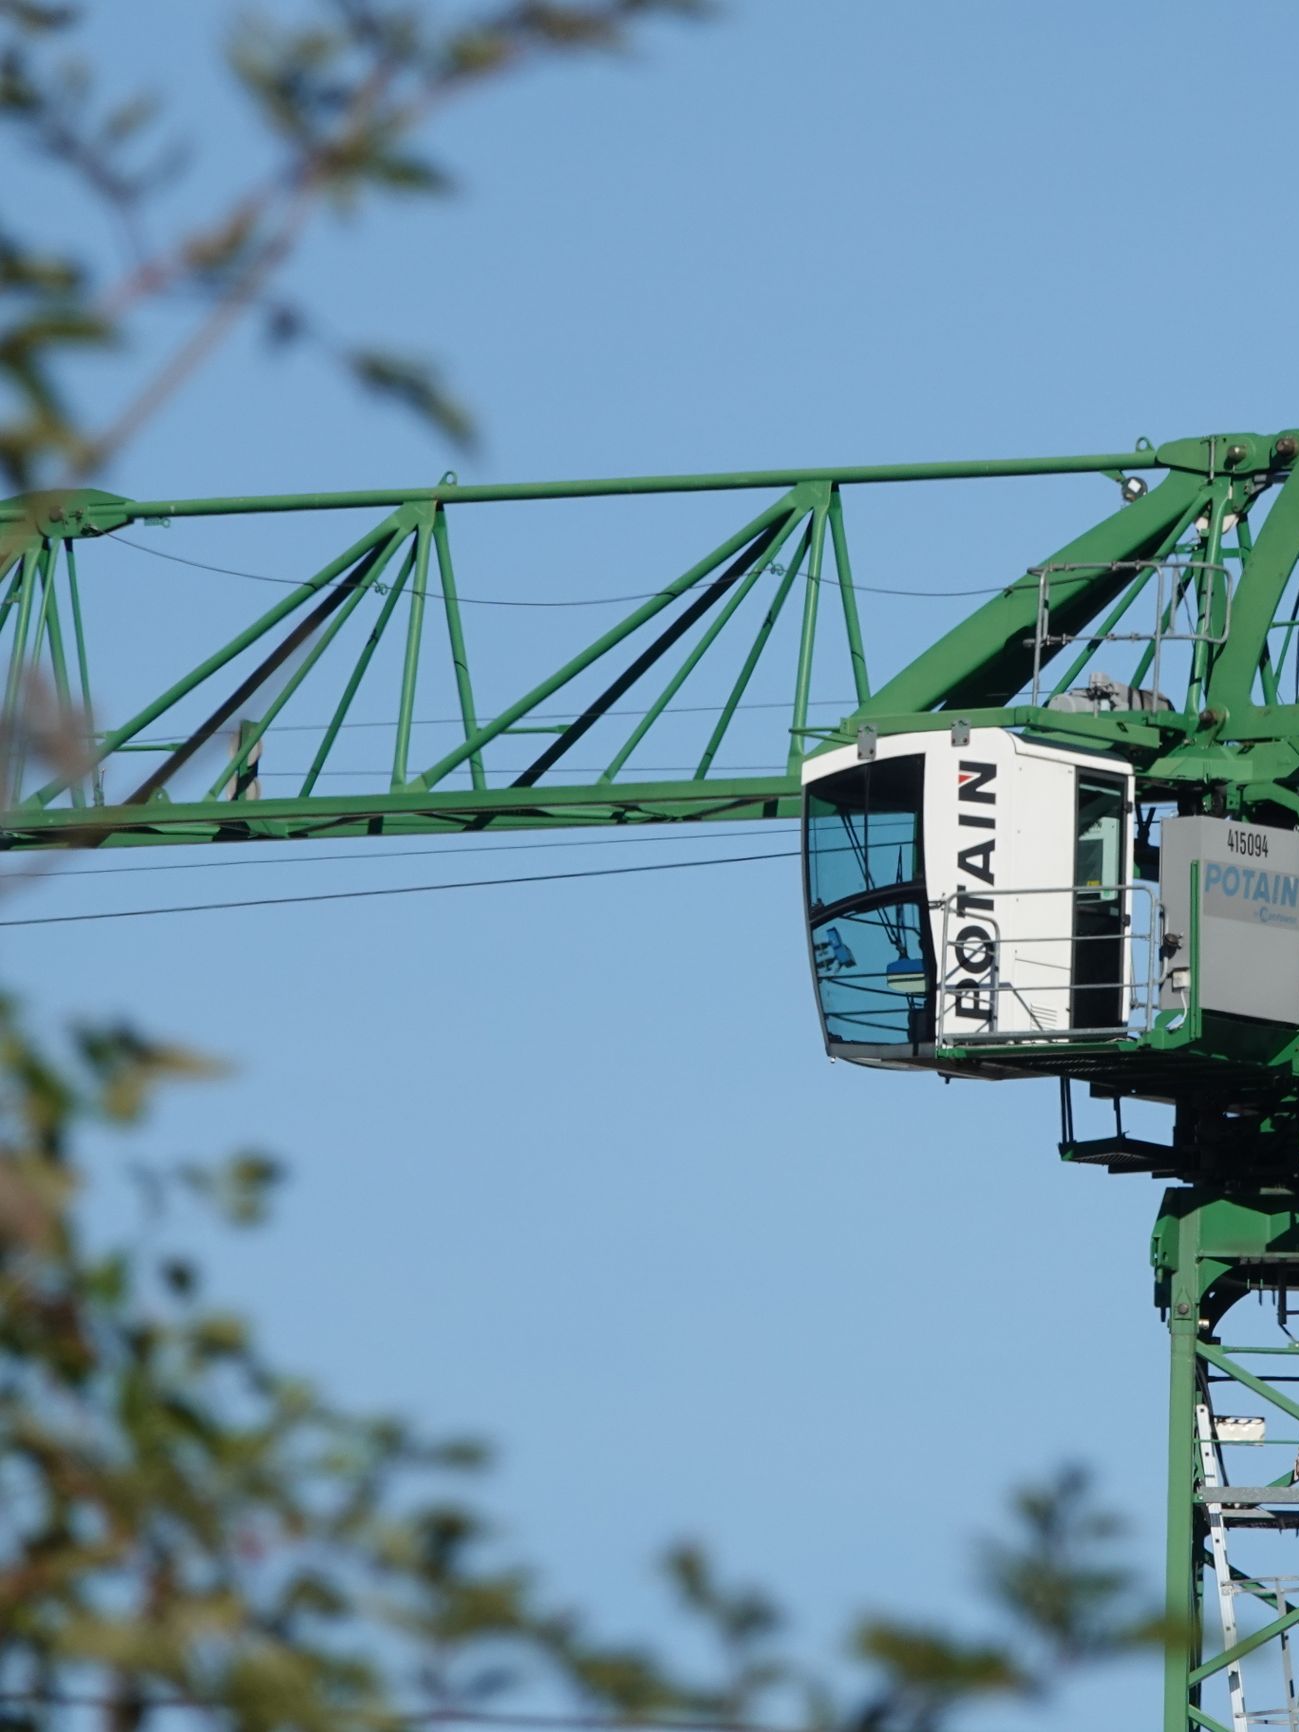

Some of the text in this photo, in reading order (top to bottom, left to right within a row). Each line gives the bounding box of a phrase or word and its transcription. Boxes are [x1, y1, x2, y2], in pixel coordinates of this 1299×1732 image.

[1227, 828, 1269, 858] 415094
[955, 760, 997, 1021] POTAIN
[1204, 863, 1299, 907] POTAIN
